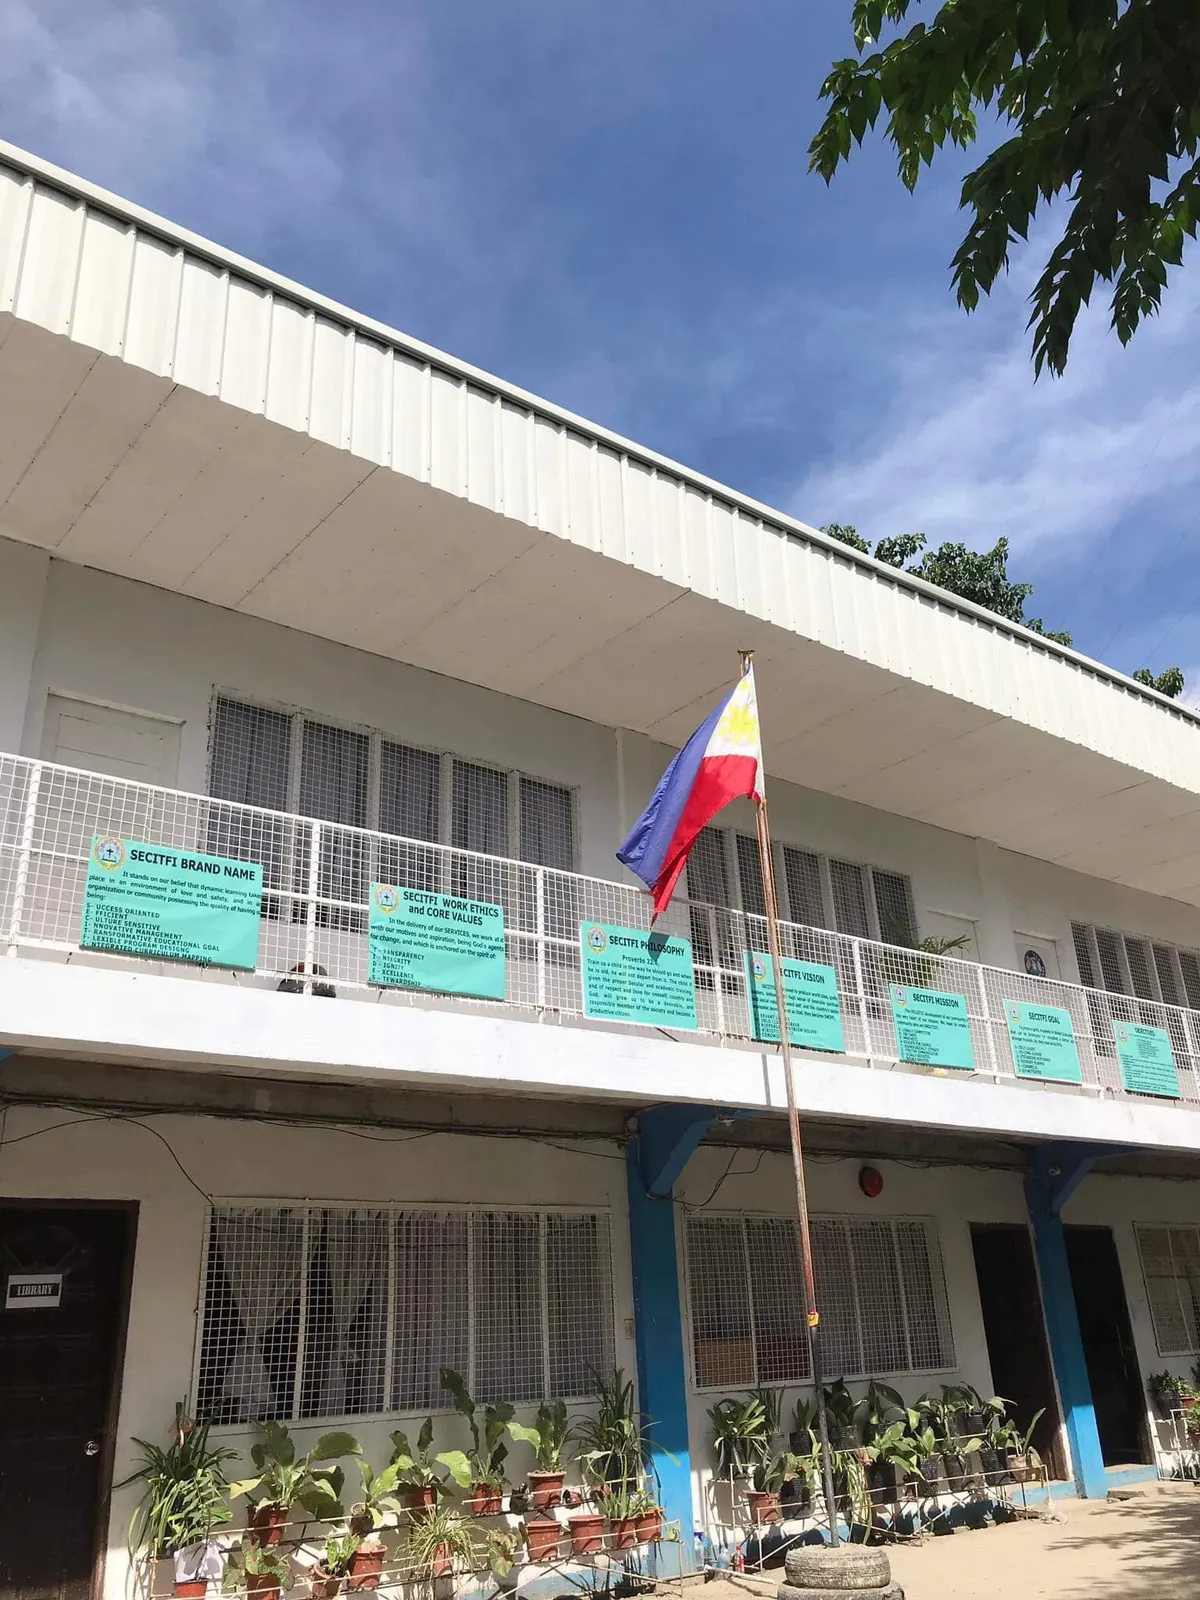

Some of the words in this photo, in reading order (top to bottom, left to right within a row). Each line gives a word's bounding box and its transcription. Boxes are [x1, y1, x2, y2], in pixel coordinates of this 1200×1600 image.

[130, 849, 177, 867] SECITFI
[181, 858, 221, 875] BRAND
[224, 866, 256, 881] NAME
[89, 874, 105, 882] place
[131, 881, 167, 892] environment
[130, 872, 149, 880] stands
[200, 884, 224, 894] dynamic
[225, 888, 247, 898] learning
[87, 882, 126, 895] organization
[134, 890, 166, 901] community
[168, 895, 198, 906] possessing
[210, 902, 229, 911] quality
[237, 907, 255, 916] having
[403, 891, 437, 906] SECITFI
[443, 899, 468, 912] WORK
[470, 904, 498, 918] ETHICS
[95, 910, 128, 920] FFICIENT
[96, 904, 123, 913] UCCESS
[125, 908, 160, 919] ORIENTED
[409, 905, 424, 916] and
[427, 908, 450, 920] CORE
[452, 912, 483, 926] VALUES
[94, 922, 134, 933] NNOVATIVE
[136, 928, 183, 940] MANAGEMENT
[95, 916, 122, 925] ULTURE
[124, 920, 161, 931] SENSITIVE
[406, 920, 426, 930] delivery
[92, 935, 122, 944] LEXIBLE
[124, 939, 157, 949] PROGRAM
[94, 929, 152, 942] RANSFORMATIVE
[154, 937, 200, 949] EDUCATIONAL
[396, 928, 416, 937] motives
[458, 939, 471, 947] being
[488, 944, 504, 953] agents
[609, 935, 638, 949] SECITFI
[641, 941, 685, 957] PHILOSOPHY
[91, 941, 133, 952] NTEGRATED
[135, 947, 180, 958] CURRICULUM
[182, 953, 212, 963] MAPPING
[414, 940, 429, 948] which
[436, 944, 459, 953] anchored
[477, 950, 489, 959] spirit
[622, 954, 645, 963] Proverbs
[383, 976, 421, 987] TEWARDSHIP
[780, 968, 801, 980] CITFI
[802, 972, 825, 984] VISION
[590, 999, 615, 1008] responsible
[912, 993, 934, 1004] SECITFI
[935, 997, 959, 1008] MISSION
[590, 1008, 614, 1016] productive
[1028, 1013, 1048, 1022] SECITFI
[1048, 1016, 1060, 1024] GOAL
[17, 1285, 52, 1296] LIBRARY
